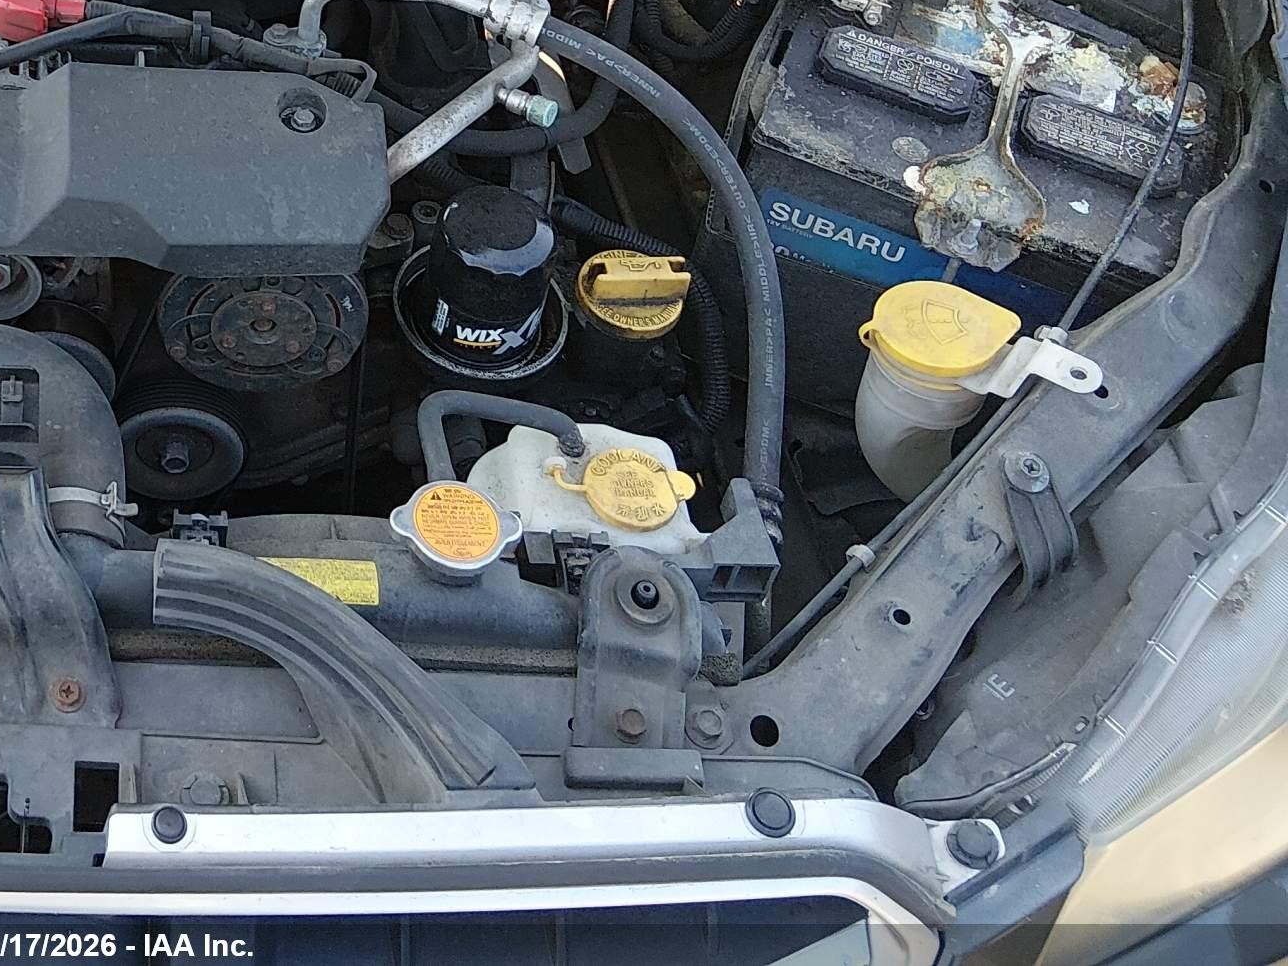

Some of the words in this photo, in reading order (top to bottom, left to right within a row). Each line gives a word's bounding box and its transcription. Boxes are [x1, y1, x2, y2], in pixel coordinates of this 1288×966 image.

[857, 34, 904, 55] DANGER
[917, 54, 959, 74] POISON
[769, 202, 906, 263] SUBARU
[596, 304, 614, 318] SEE
[455, 324, 505, 342] WIX
[591, 449, 667, 476] COOLANT
